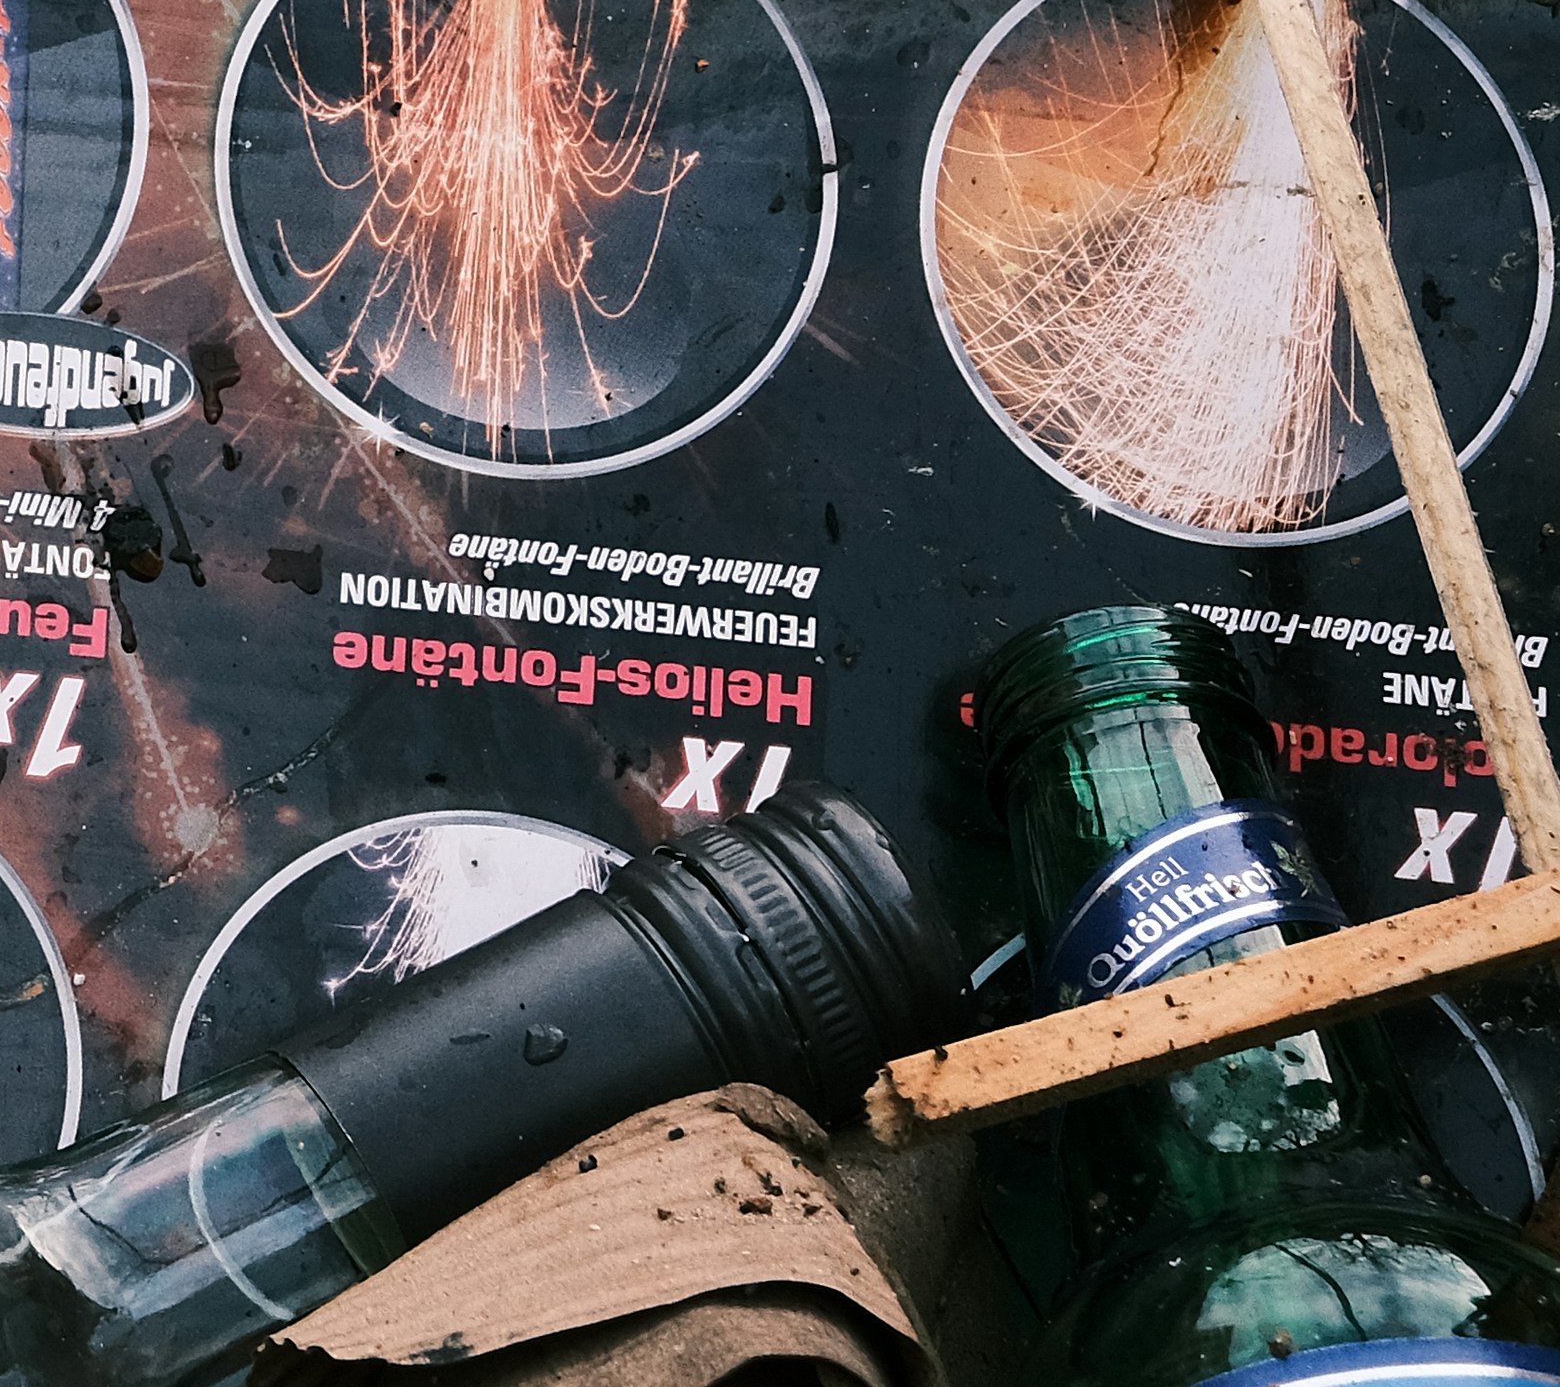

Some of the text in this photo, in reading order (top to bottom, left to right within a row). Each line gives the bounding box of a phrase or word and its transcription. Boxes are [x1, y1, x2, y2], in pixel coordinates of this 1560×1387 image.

[446, 531, 820, 599] Brillant-Boden-Fontäne
[338, 571, 817, 647] FEUERWERKSKOMBINATION
[329, 630, 814, 726] Helios-Fontäne
[1379, 670, 1546, 721] FTÄNE
[1124, 855, 1189, 902] Hell
